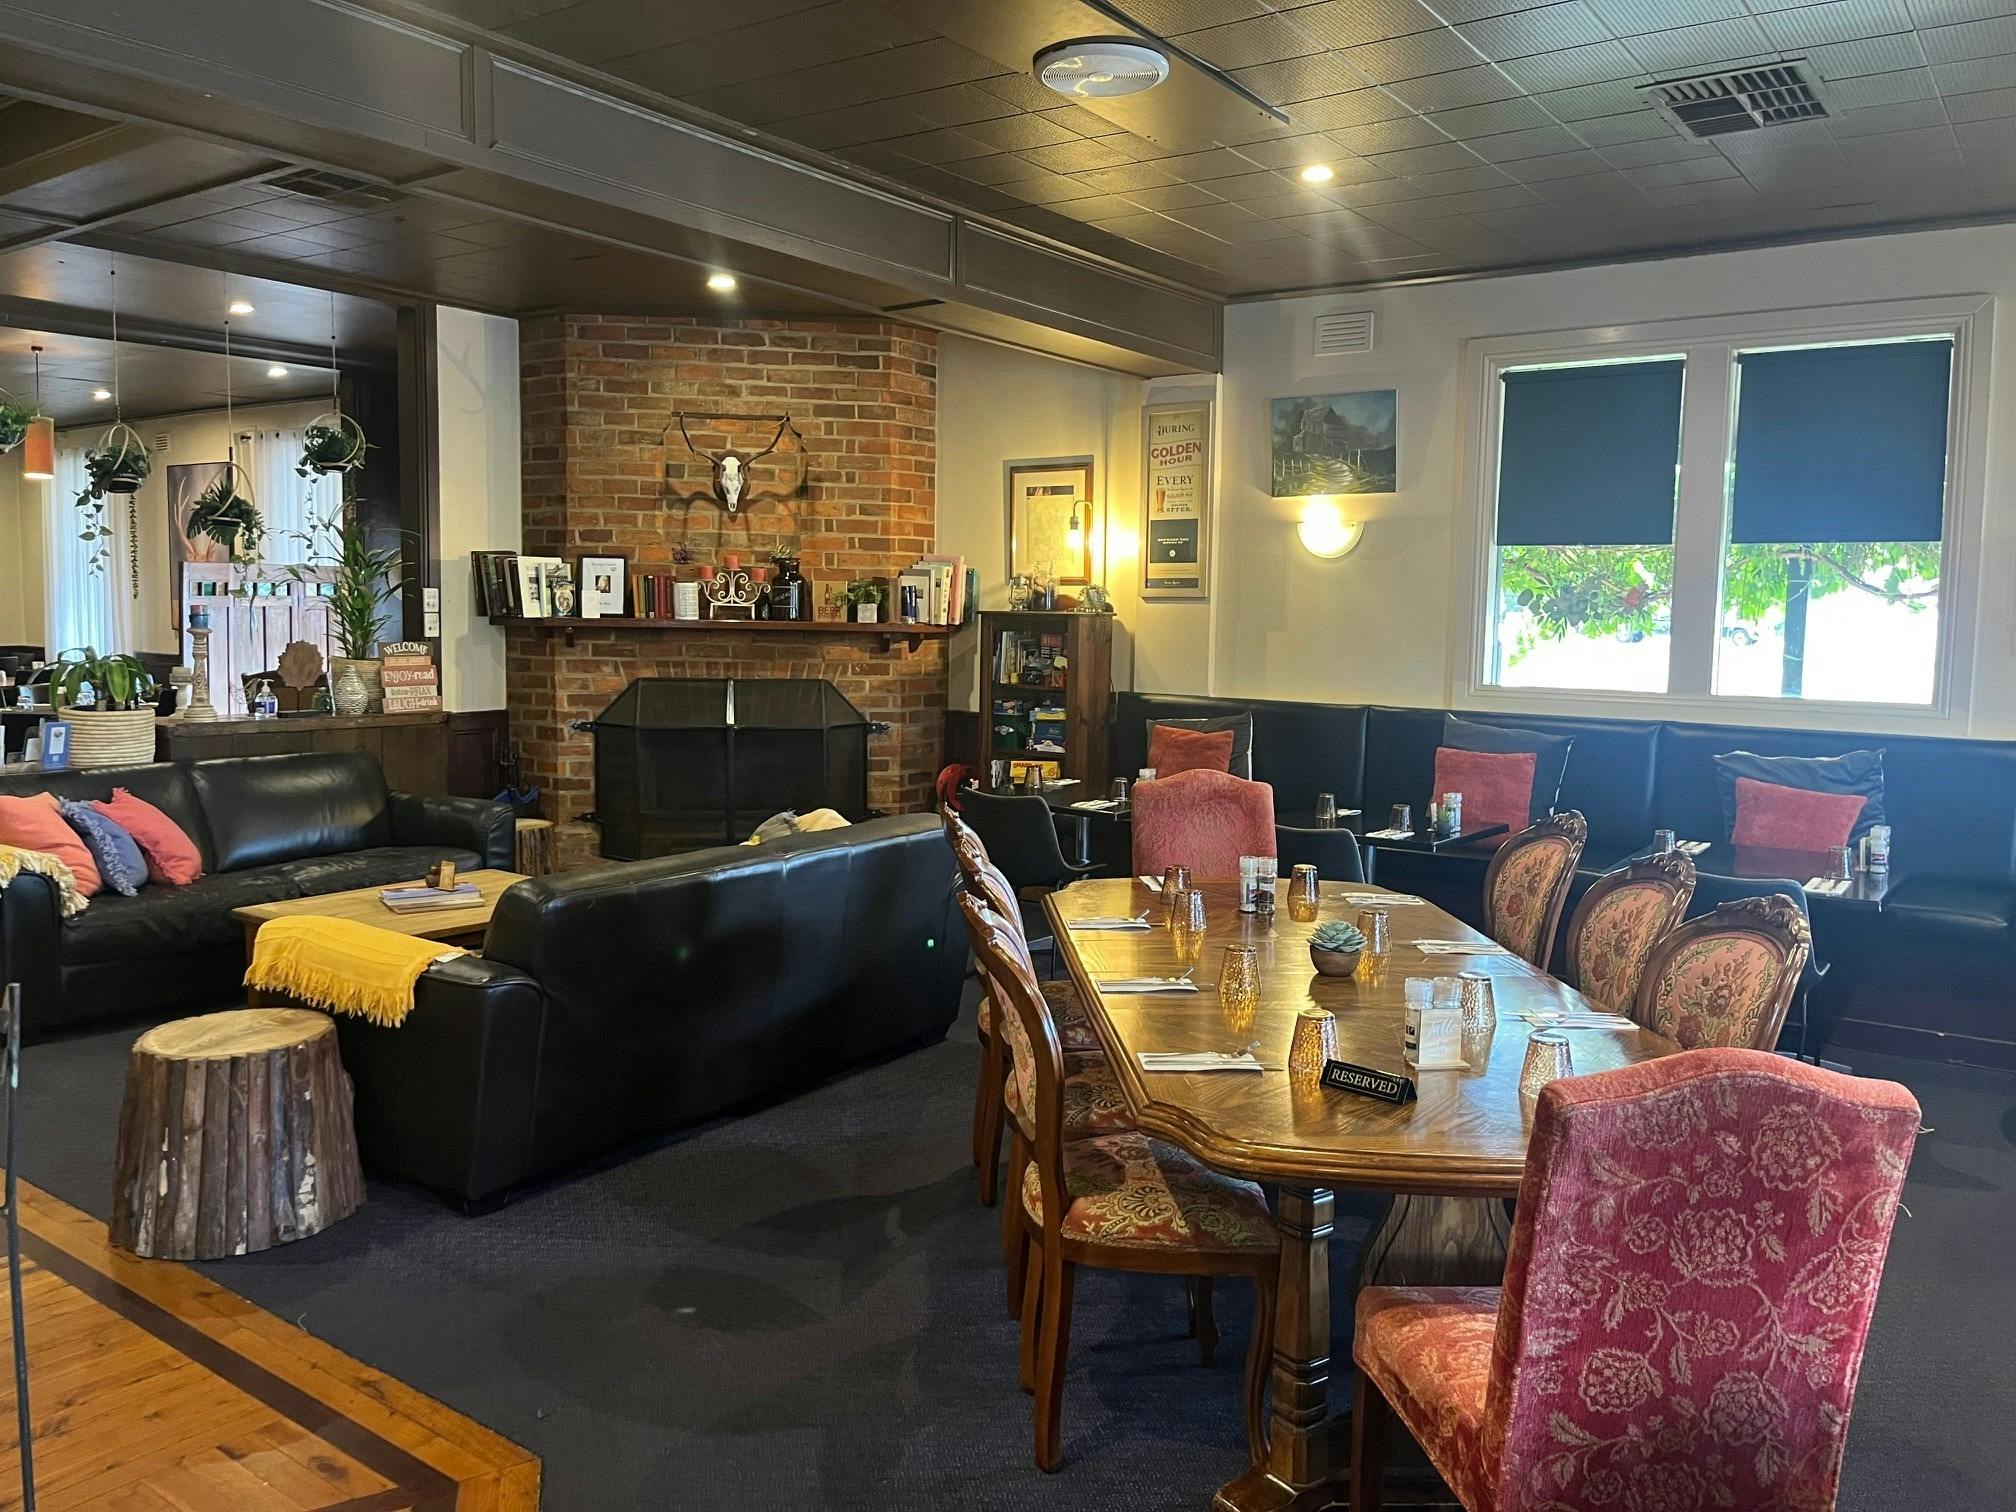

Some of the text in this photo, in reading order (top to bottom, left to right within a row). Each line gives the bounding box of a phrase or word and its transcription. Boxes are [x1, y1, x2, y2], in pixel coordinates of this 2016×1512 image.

[1157, 424, 1195, 436] DURING
[1151, 442, 1202, 459] GOLDEN
[1160, 455, 1193, 466] HOUR
[1157, 475, 1194, 486] EVERY
[383, 641, 428, 655] WELCOME
[1331, 1068, 1398, 1094] RESERVED
